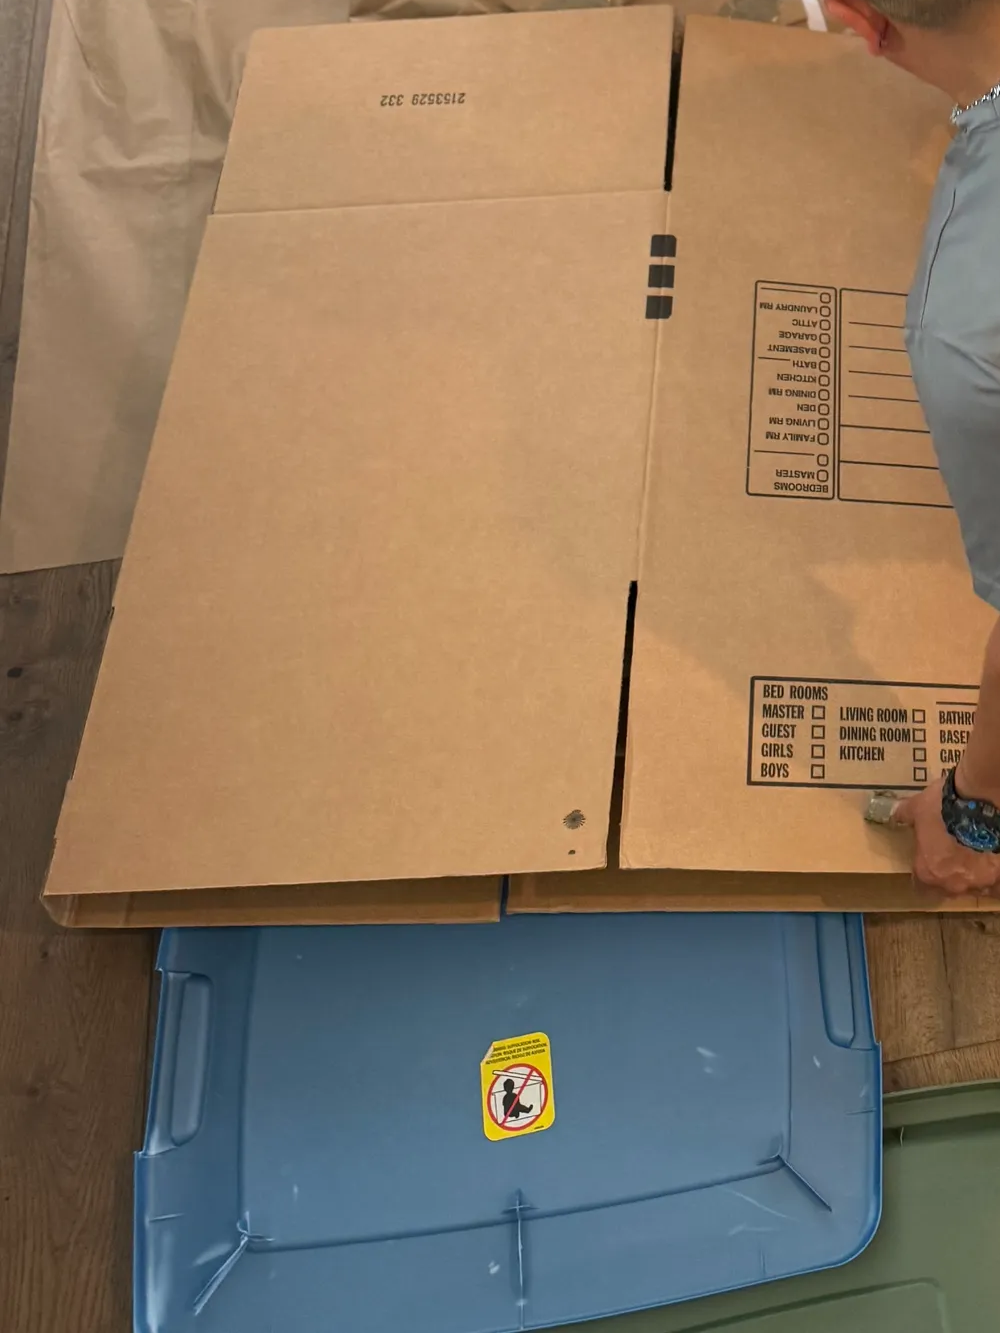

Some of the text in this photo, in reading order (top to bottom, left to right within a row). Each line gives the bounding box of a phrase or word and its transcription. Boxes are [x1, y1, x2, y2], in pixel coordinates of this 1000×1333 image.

[380, 93, 466, 107] 2153529 332
[774, 304, 818, 314] LAUNDRY
[791, 318, 817, 327] ATTIC
[778, 331, 817, 341] GARAGE
[767, 344, 817, 355] BASEMENT
[792, 360, 817, 369] BATH
[776, 373, 816, 383] KITCHEN
[785, 390, 816, 399] DINING
[796, 403, 816, 412] DEN
[768, 416, 816, 428] LIVING RM
[765, 431, 816, 443] FAMILY RM
[775, 469, 814, 478] MASTER
[773, 482, 829, 493] BEDROOMS
[763, 684, 829, 701] BED ROOMS
[762, 704, 805, 720] MASTER
[840, 706, 908, 723] LIVING ROOM
[761, 724, 797, 738] GUEST
[839, 726, 911, 742] DINING ROOM
[761, 743, 794, 758] GIRLS
[839, 745, 885, 761] KITCHEN
[760, 762, 789, 778] BOYS
